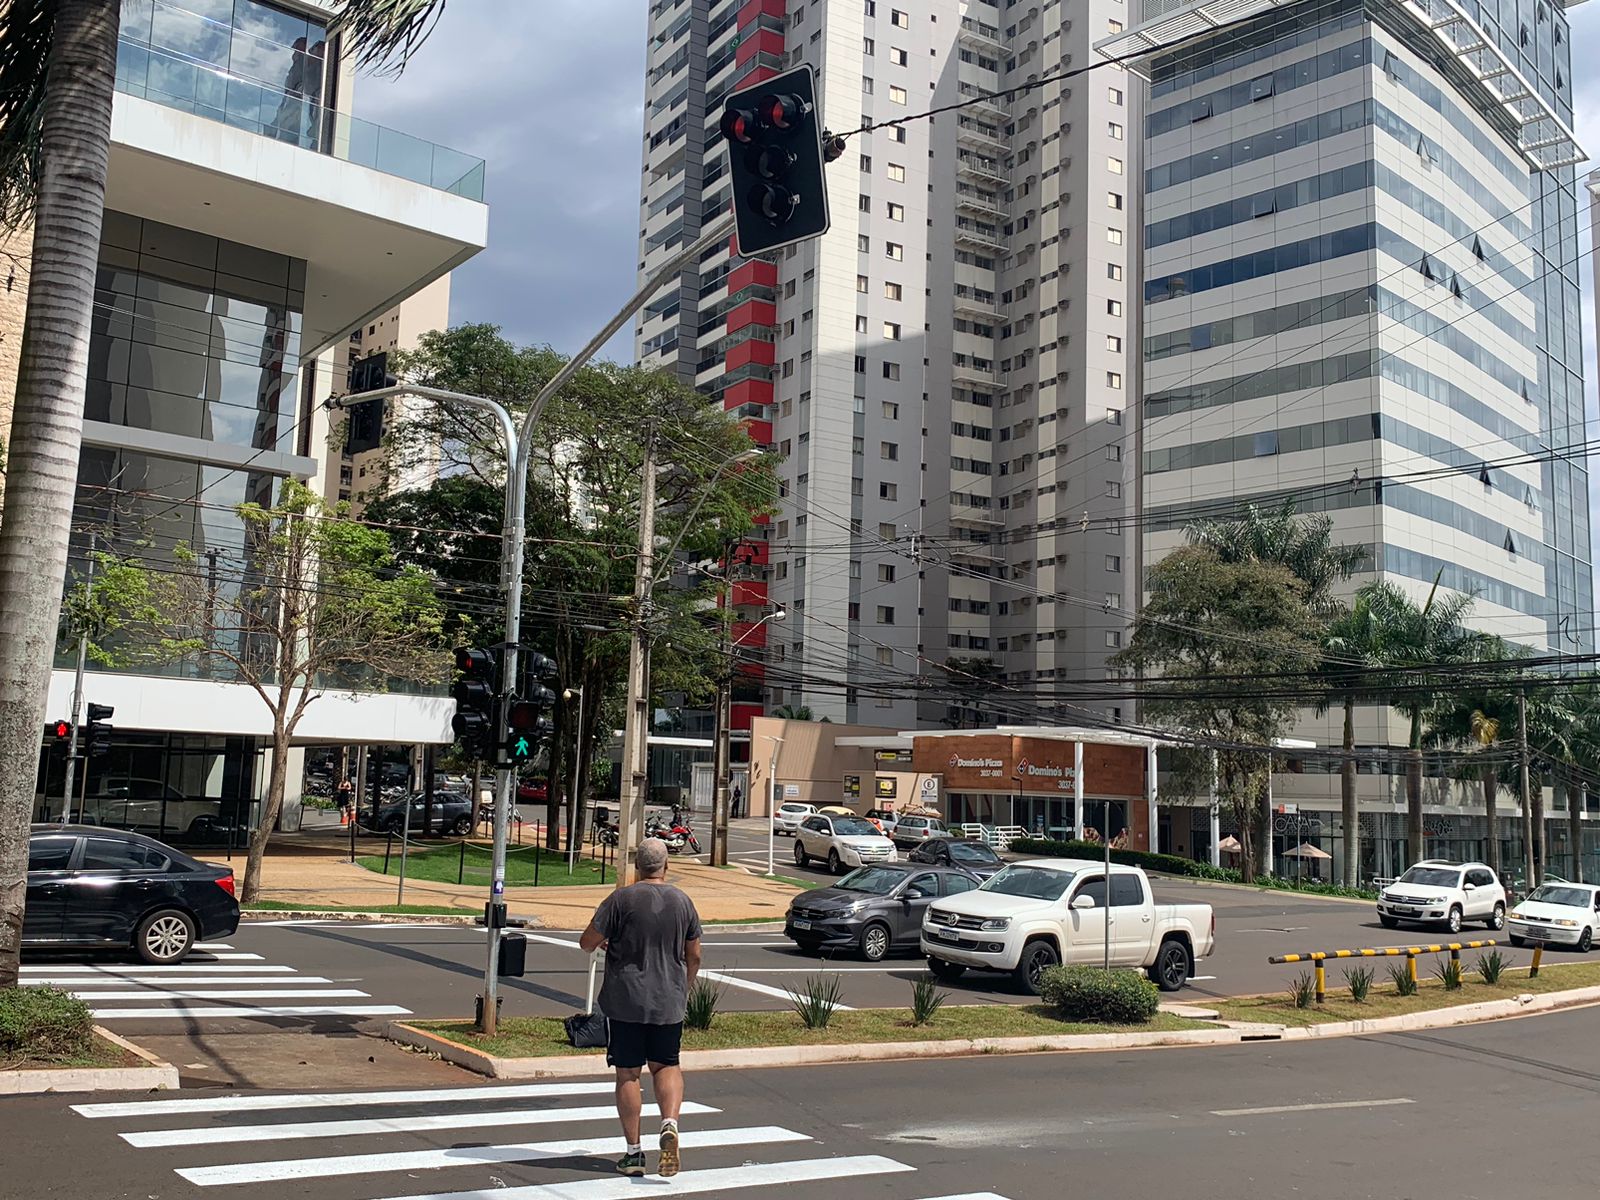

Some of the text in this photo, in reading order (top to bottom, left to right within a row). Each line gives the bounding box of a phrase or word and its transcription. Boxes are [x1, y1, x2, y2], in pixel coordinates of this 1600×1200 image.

[957, 758, 1003, 767] Domino's Pizza
[1028, 764, 1062, 776] Domino's
